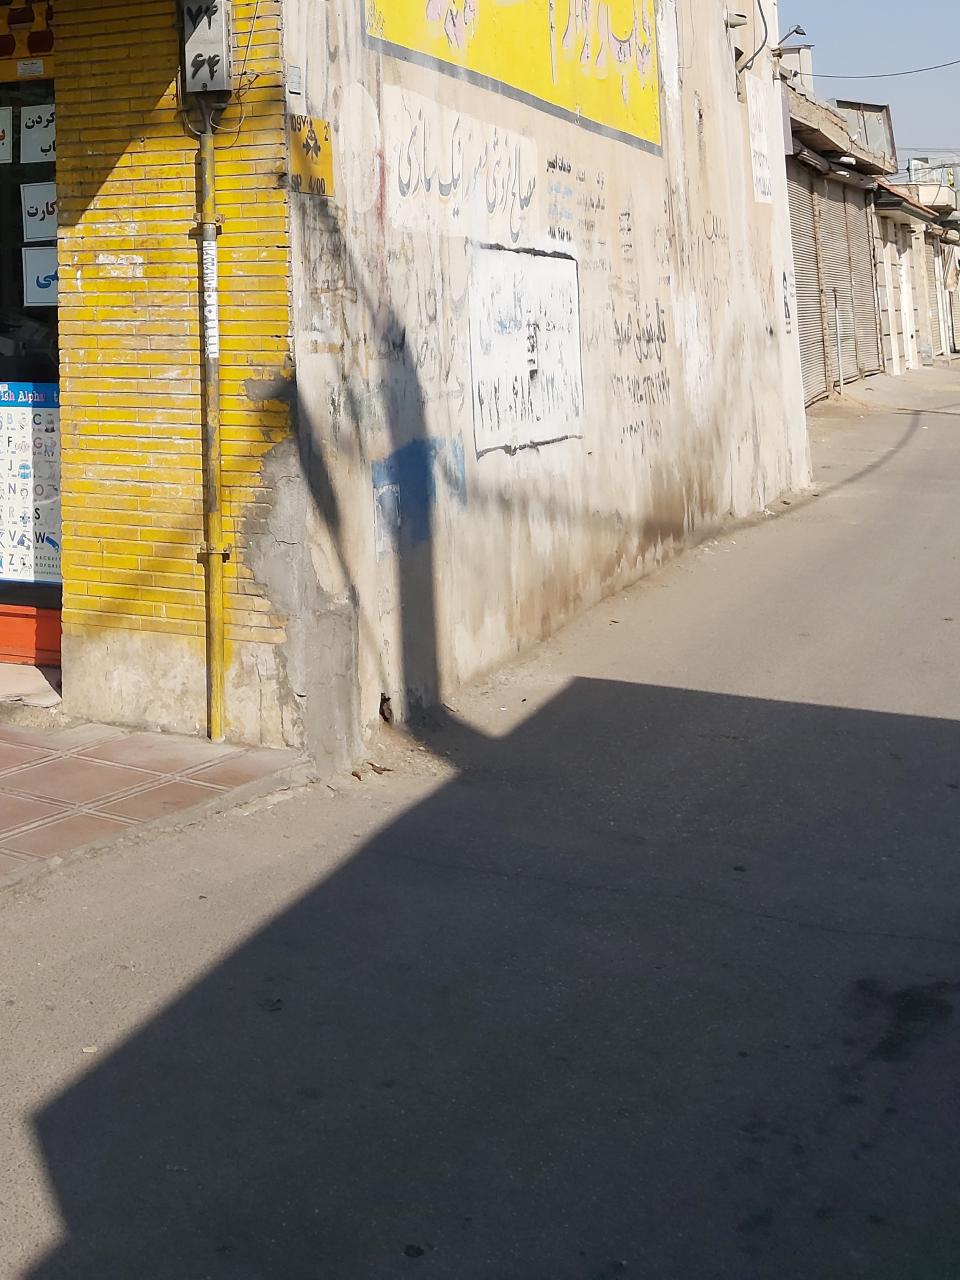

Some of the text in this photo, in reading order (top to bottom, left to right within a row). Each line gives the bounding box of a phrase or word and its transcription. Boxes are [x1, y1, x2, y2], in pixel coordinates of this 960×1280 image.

[18, 390, 58, 403] Alphat
[32, 413, 42, 425] C
[7, 436, 13, 447] F
[33, 437, 43, 449] G
[8, 459, 13, 471] J
[8, 483, 16, 495] N
[34, 484, 44, 496] O
[34, 507, 41, 520] S
[8, 530, 17, 541] V
[34, 531, 46, 543] W
[8, 553, 15, 565] Z
